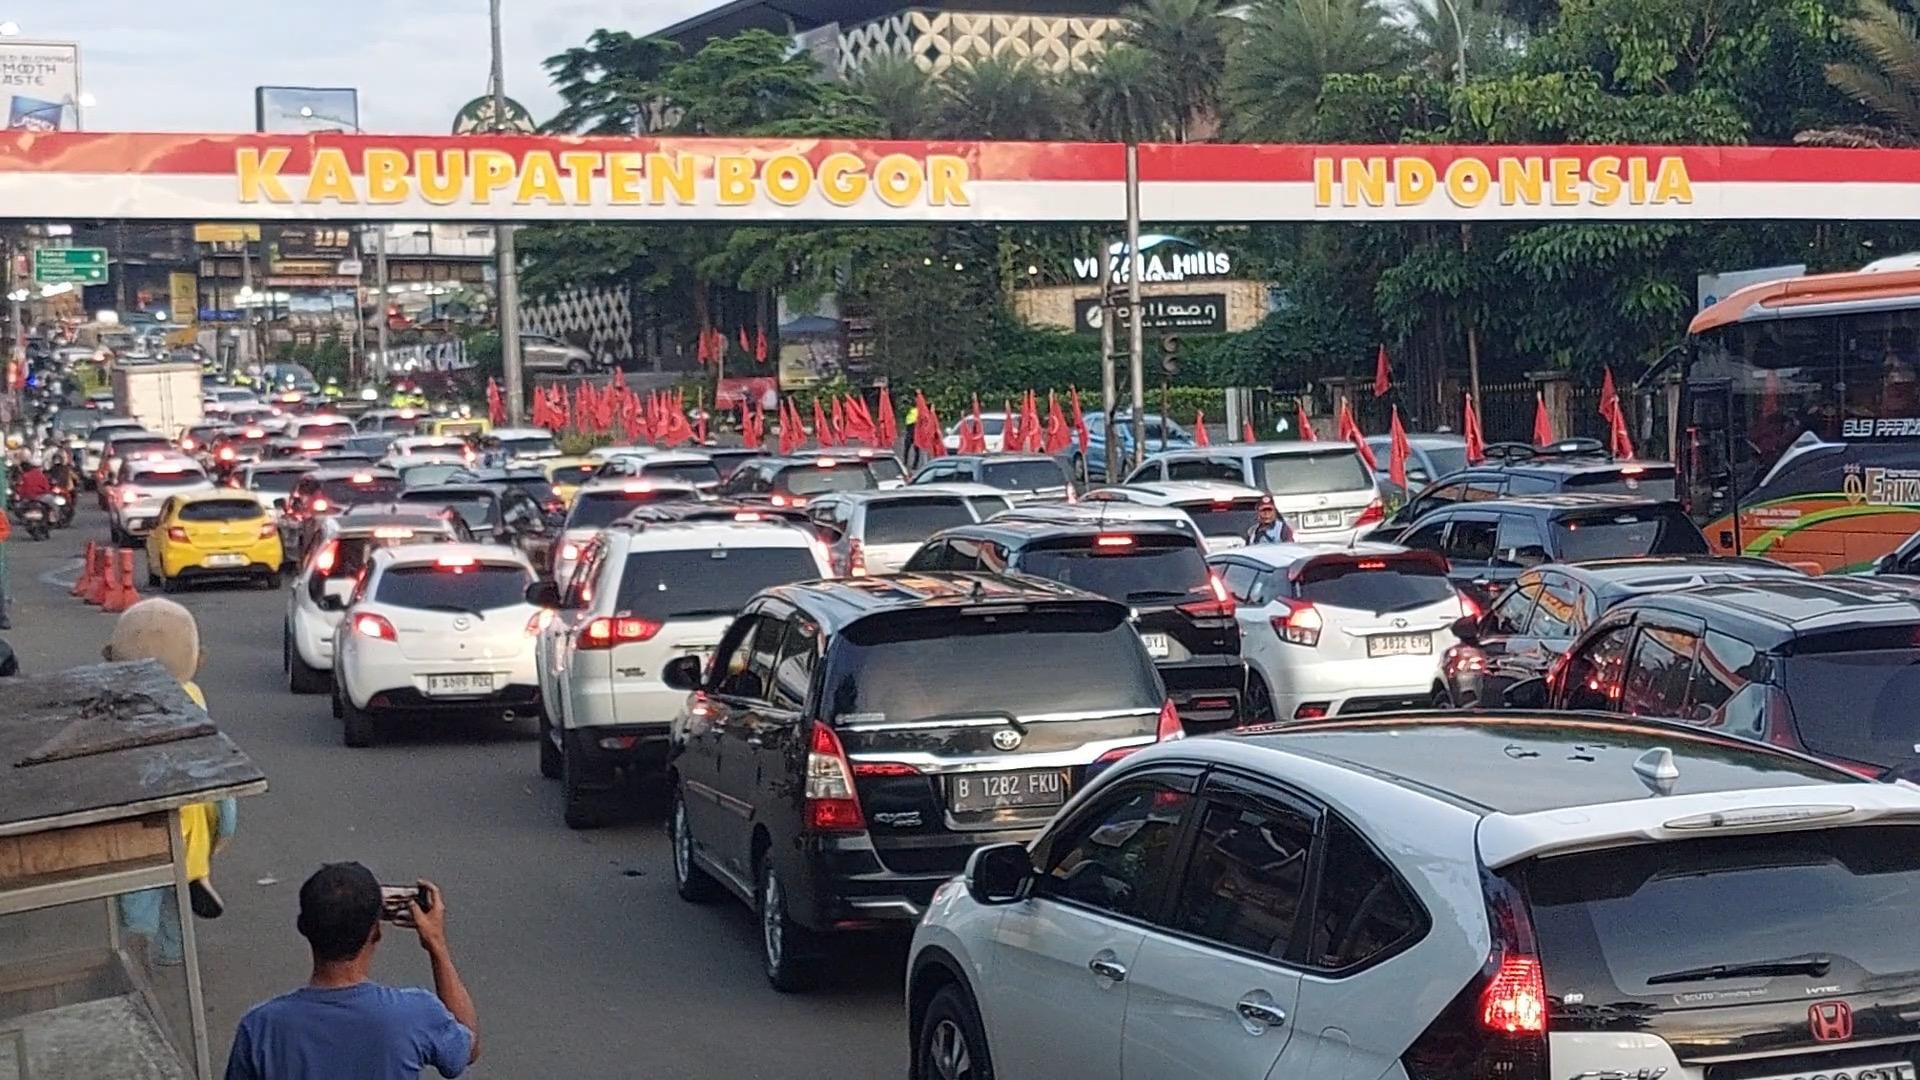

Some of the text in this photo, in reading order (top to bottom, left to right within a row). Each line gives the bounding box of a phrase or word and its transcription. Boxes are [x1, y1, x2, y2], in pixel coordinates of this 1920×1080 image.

[0, 63, 56, 75] MOOTH
[0, 75, 44, 86] ASTE
[236, 147, 971, 207] KABUPATEN BOGOR
[1314, 156, 1694, 208] INDONESIA
[959, 772, 1059, 798] B 1282 FKU
